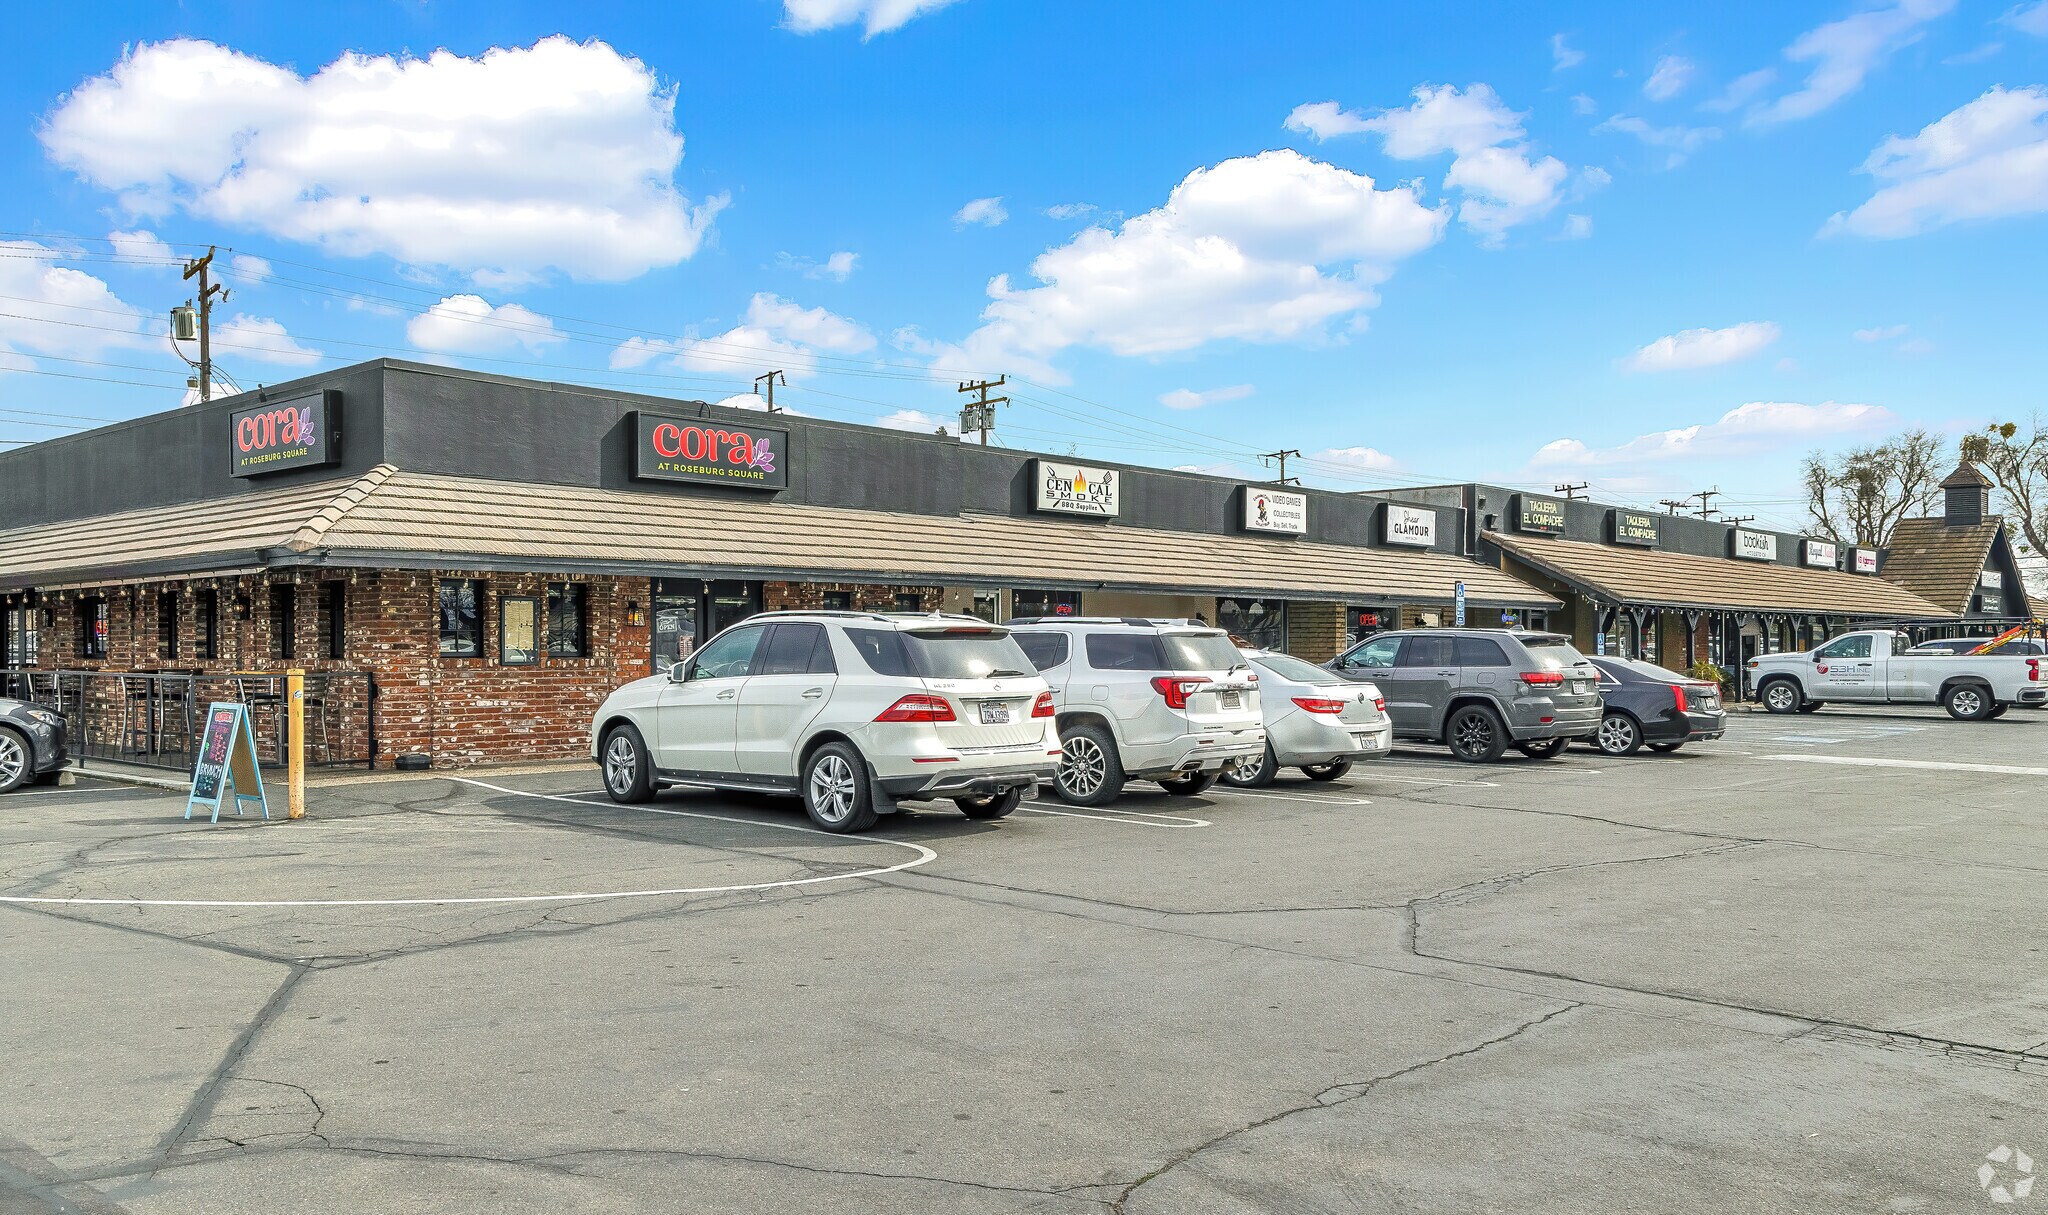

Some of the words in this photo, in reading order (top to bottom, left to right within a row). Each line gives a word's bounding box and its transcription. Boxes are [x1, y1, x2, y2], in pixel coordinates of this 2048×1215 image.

[238, 407, 299, 452] cora
[653, 423, 754, 465] cora
[241, 458, 248, 466] AT
[249, 452, 281, 464] ROSEBURG
[283, 447, 308, 459] SQUARE
[674, 464, 725, 476] ROSEBURG
[728, 469, 764, 480] SQUARE
[1047, 478, 1072, 492] CEN
[1089, 484, 1112, 496] CAL
[1062, 501, 1075, 509] BBQ
[1272, 495, 1285, 504] VIDEO
[1286, 497, 1301, 507] GAMES
[1529, 501, 1557, 514] TAQUERIA
[1273, 510, 1300, 519] COLLECTIBLES
[1523, 514, 1532, 524] EL
[1533, 514, 1564, 527] COMPADRE
[1625, 515, 1651, 528] TAQUERIA
[1394, 523, 1429, 537] GLAMOUR
[1619, 526, 1628, 537] EL
[1629, 527, 1657, 540] COMPADRE
[1743, 531, 1769, 551] bookish
[1359, 614, 1377, 625] OPEN
[660, 623, 676, 631] OPEN
[1830, 665, 1856, 673] S3H
[199, 762, 223, 780] BRUNCH
